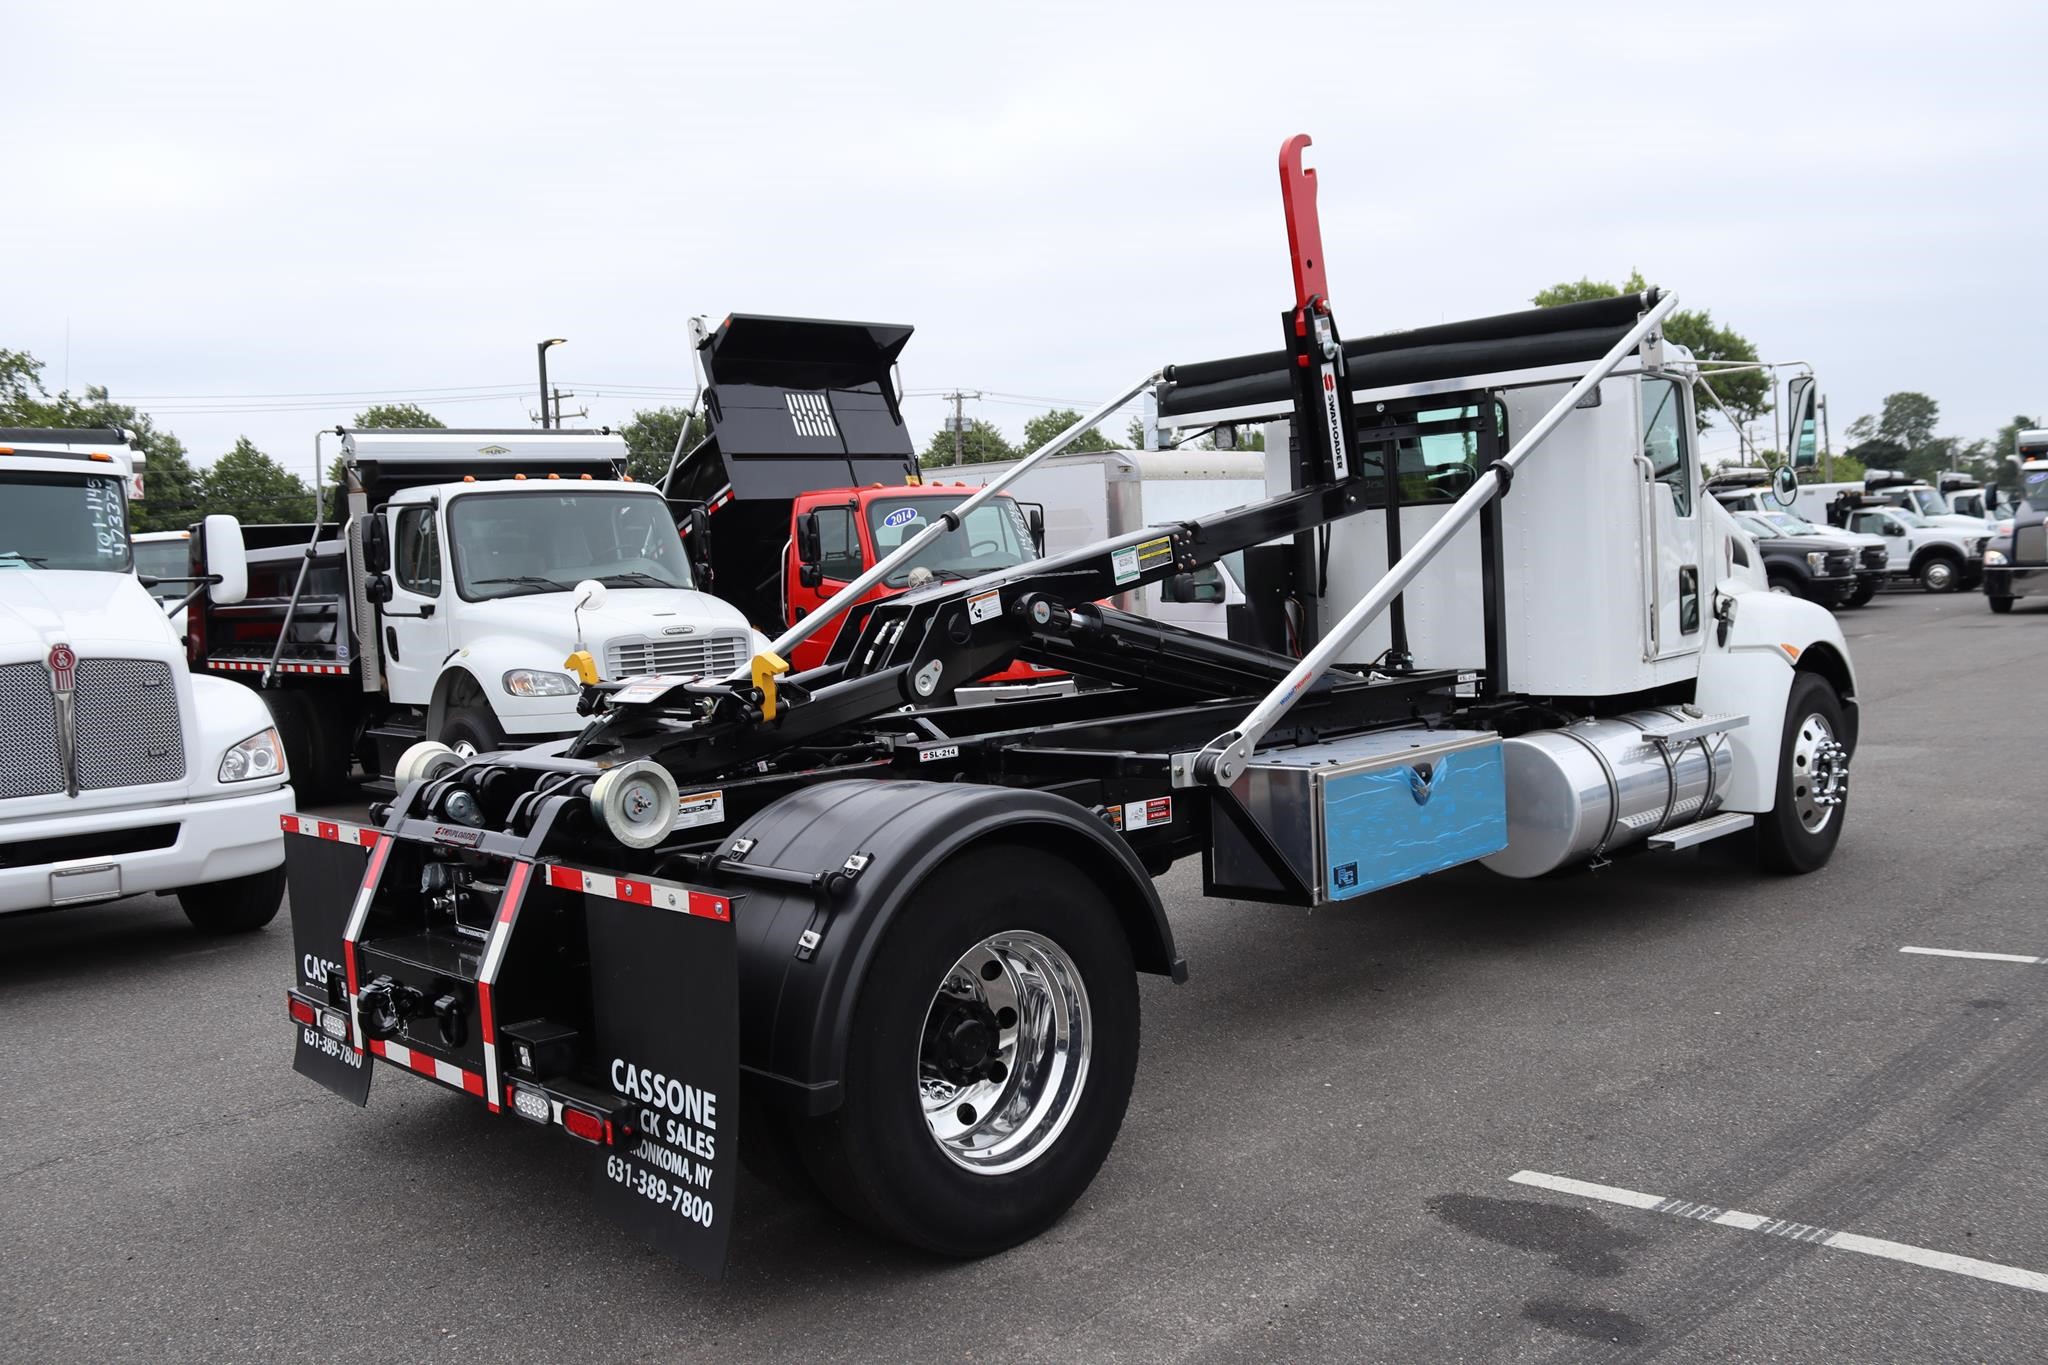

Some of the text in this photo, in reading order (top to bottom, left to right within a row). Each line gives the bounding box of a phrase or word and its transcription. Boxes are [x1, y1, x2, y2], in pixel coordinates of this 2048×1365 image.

[1328, 394, 1343, 469] SWAPLOADER
[891, 509, 912, 526] 2014
[304, 1028, 362, 1069] 631-389-7800
[611, 1058, 716, 1130] CASSONE
[666, 1119, 715, 1160] SALES
[607, 1155, 713, 1228] 631-389-7800
[695, 1162, 713, 1190] NY
